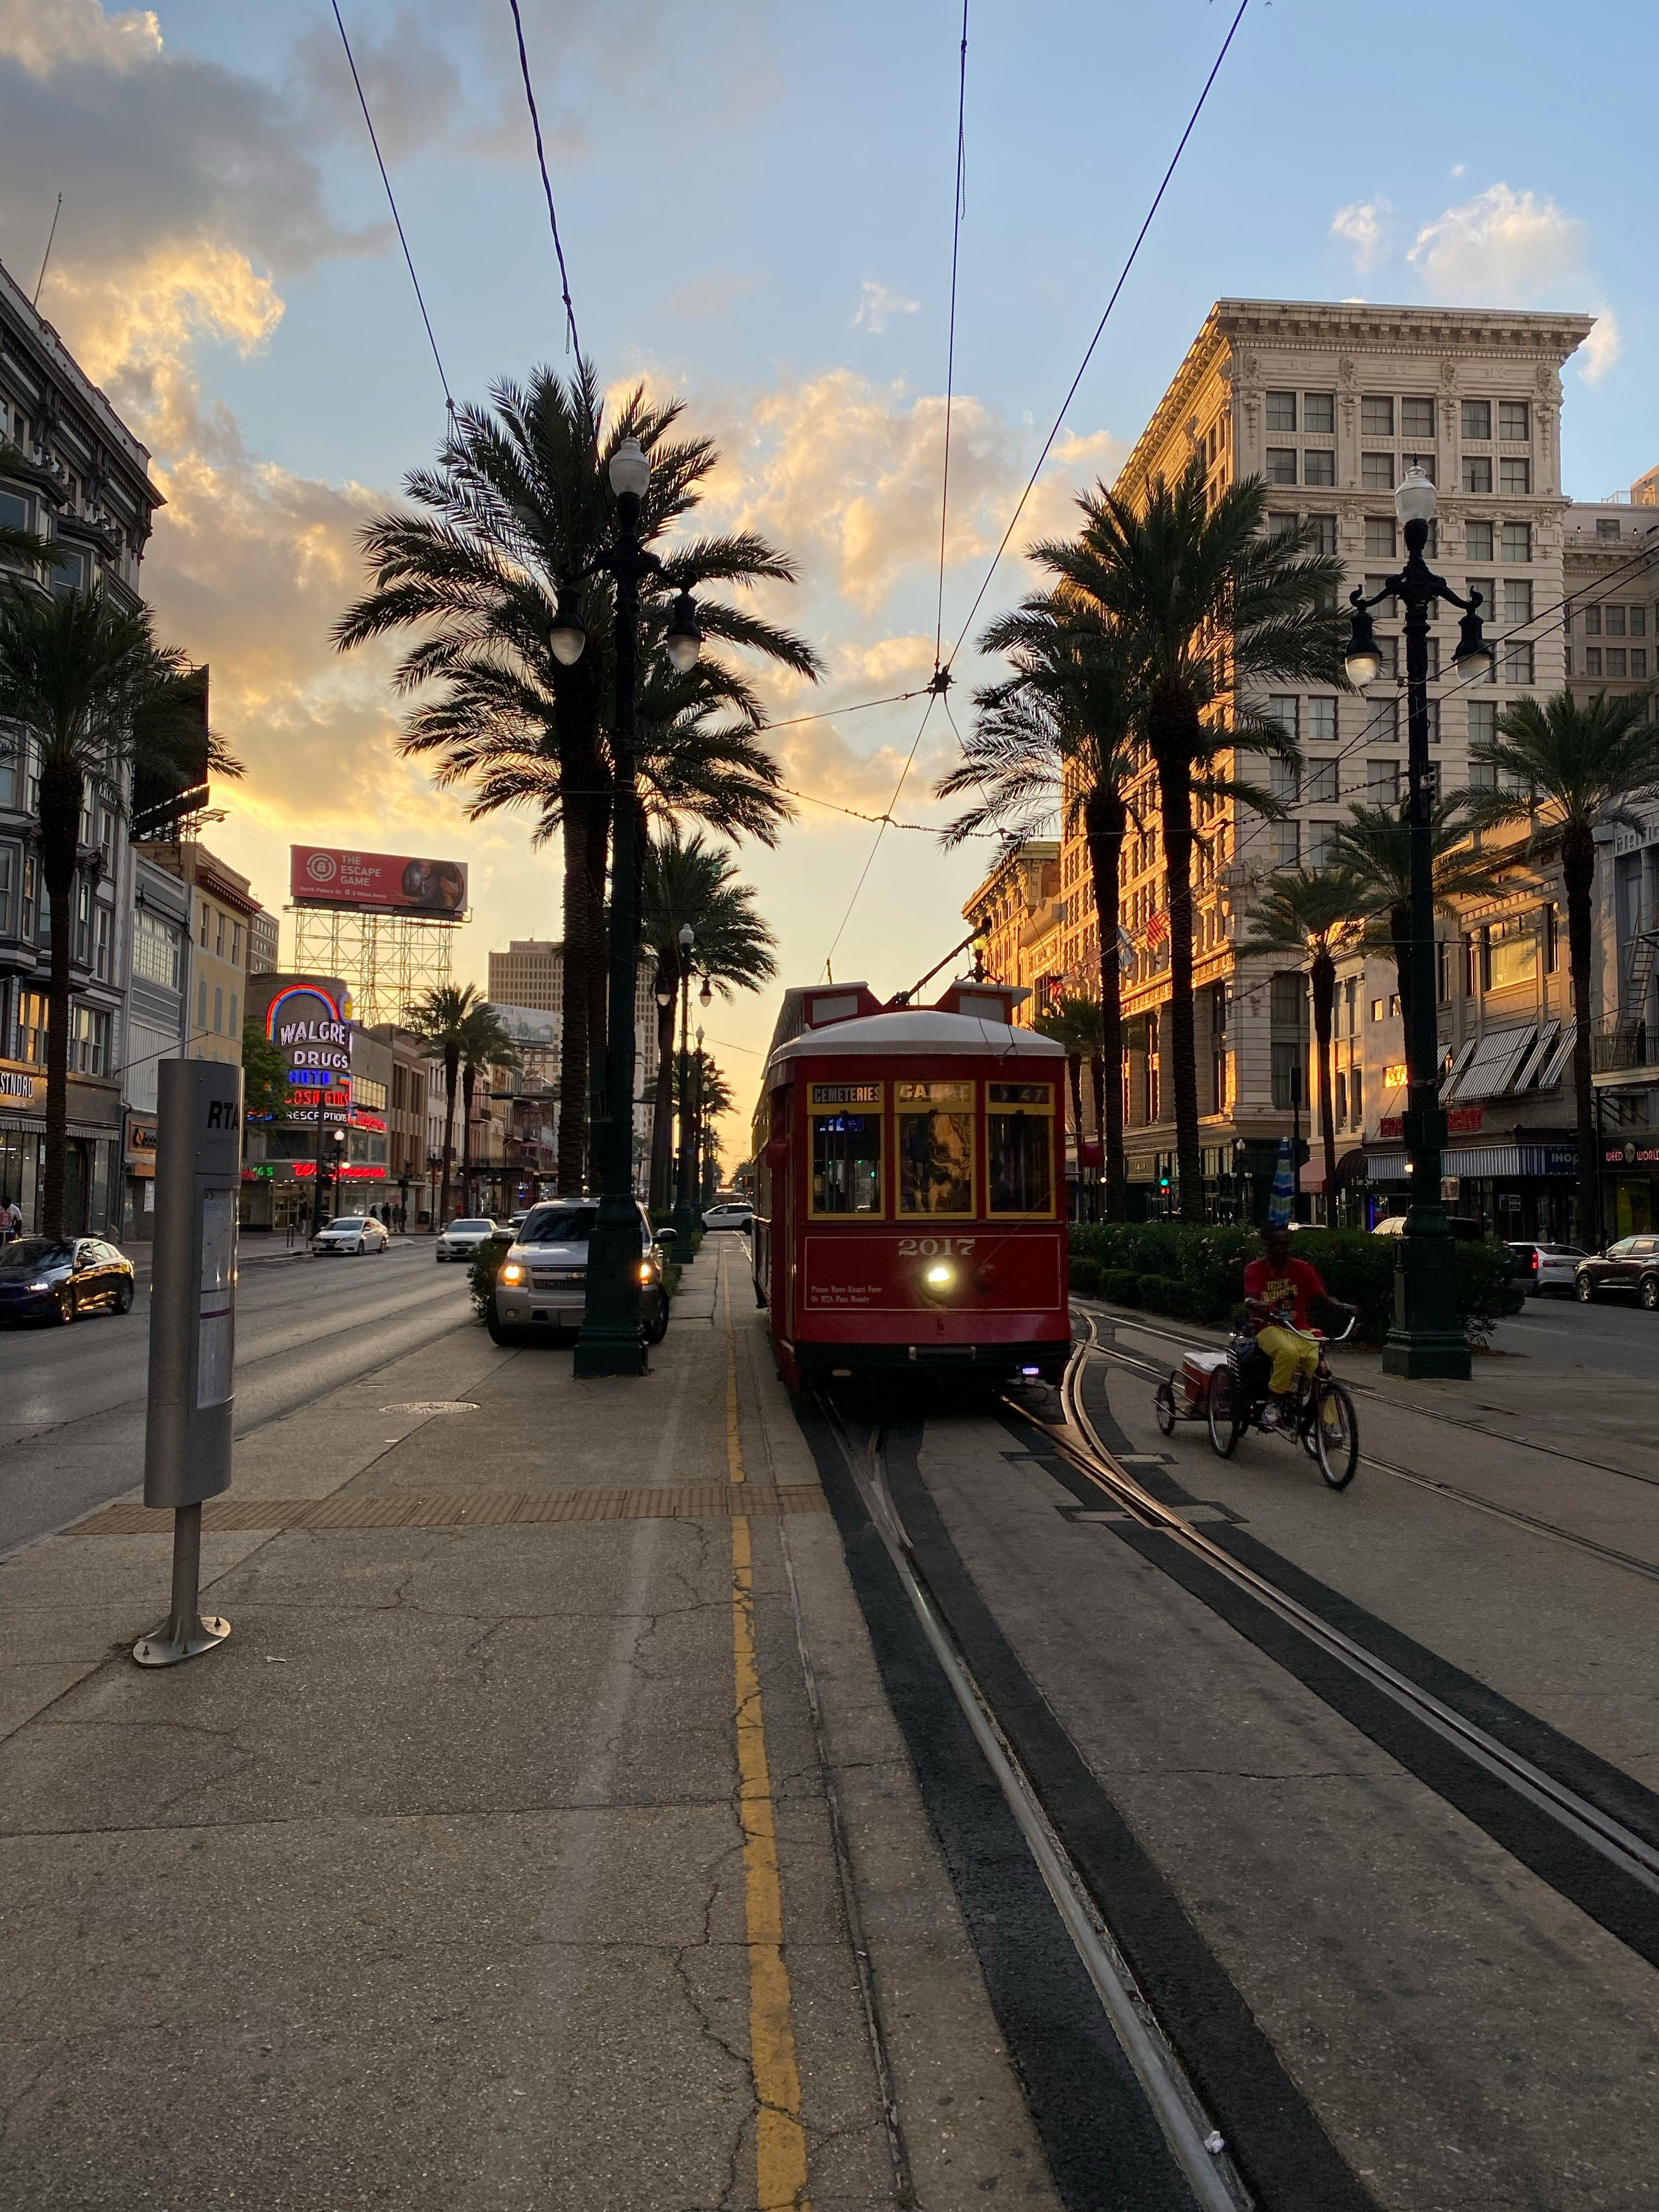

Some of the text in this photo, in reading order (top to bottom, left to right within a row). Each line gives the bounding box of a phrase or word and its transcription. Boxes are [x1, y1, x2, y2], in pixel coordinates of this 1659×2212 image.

[341, 855, 362, 865] THE
[341, 865, 382, 877] ESCAPE
[341, 876, 370, 887] GAME
[512, 943, 539, 951] Tulane
[294, 1050, 348, 1069] DRUGS
[286, 1069, 331, 1086] HOTO
[0, 1073, 33, 1098] STNDRD
[814, 1086, 880, 1103] CEMETERIES
[207, 1101, 239, 1130] RTA
[1551, 1153, 1580, 1166] IHOP
[1606, 1149, 1659, 1162] WEED WORLD
[898, 1238, 975, 1256] 2017
[850, 1295, 870, 1304] Ready
